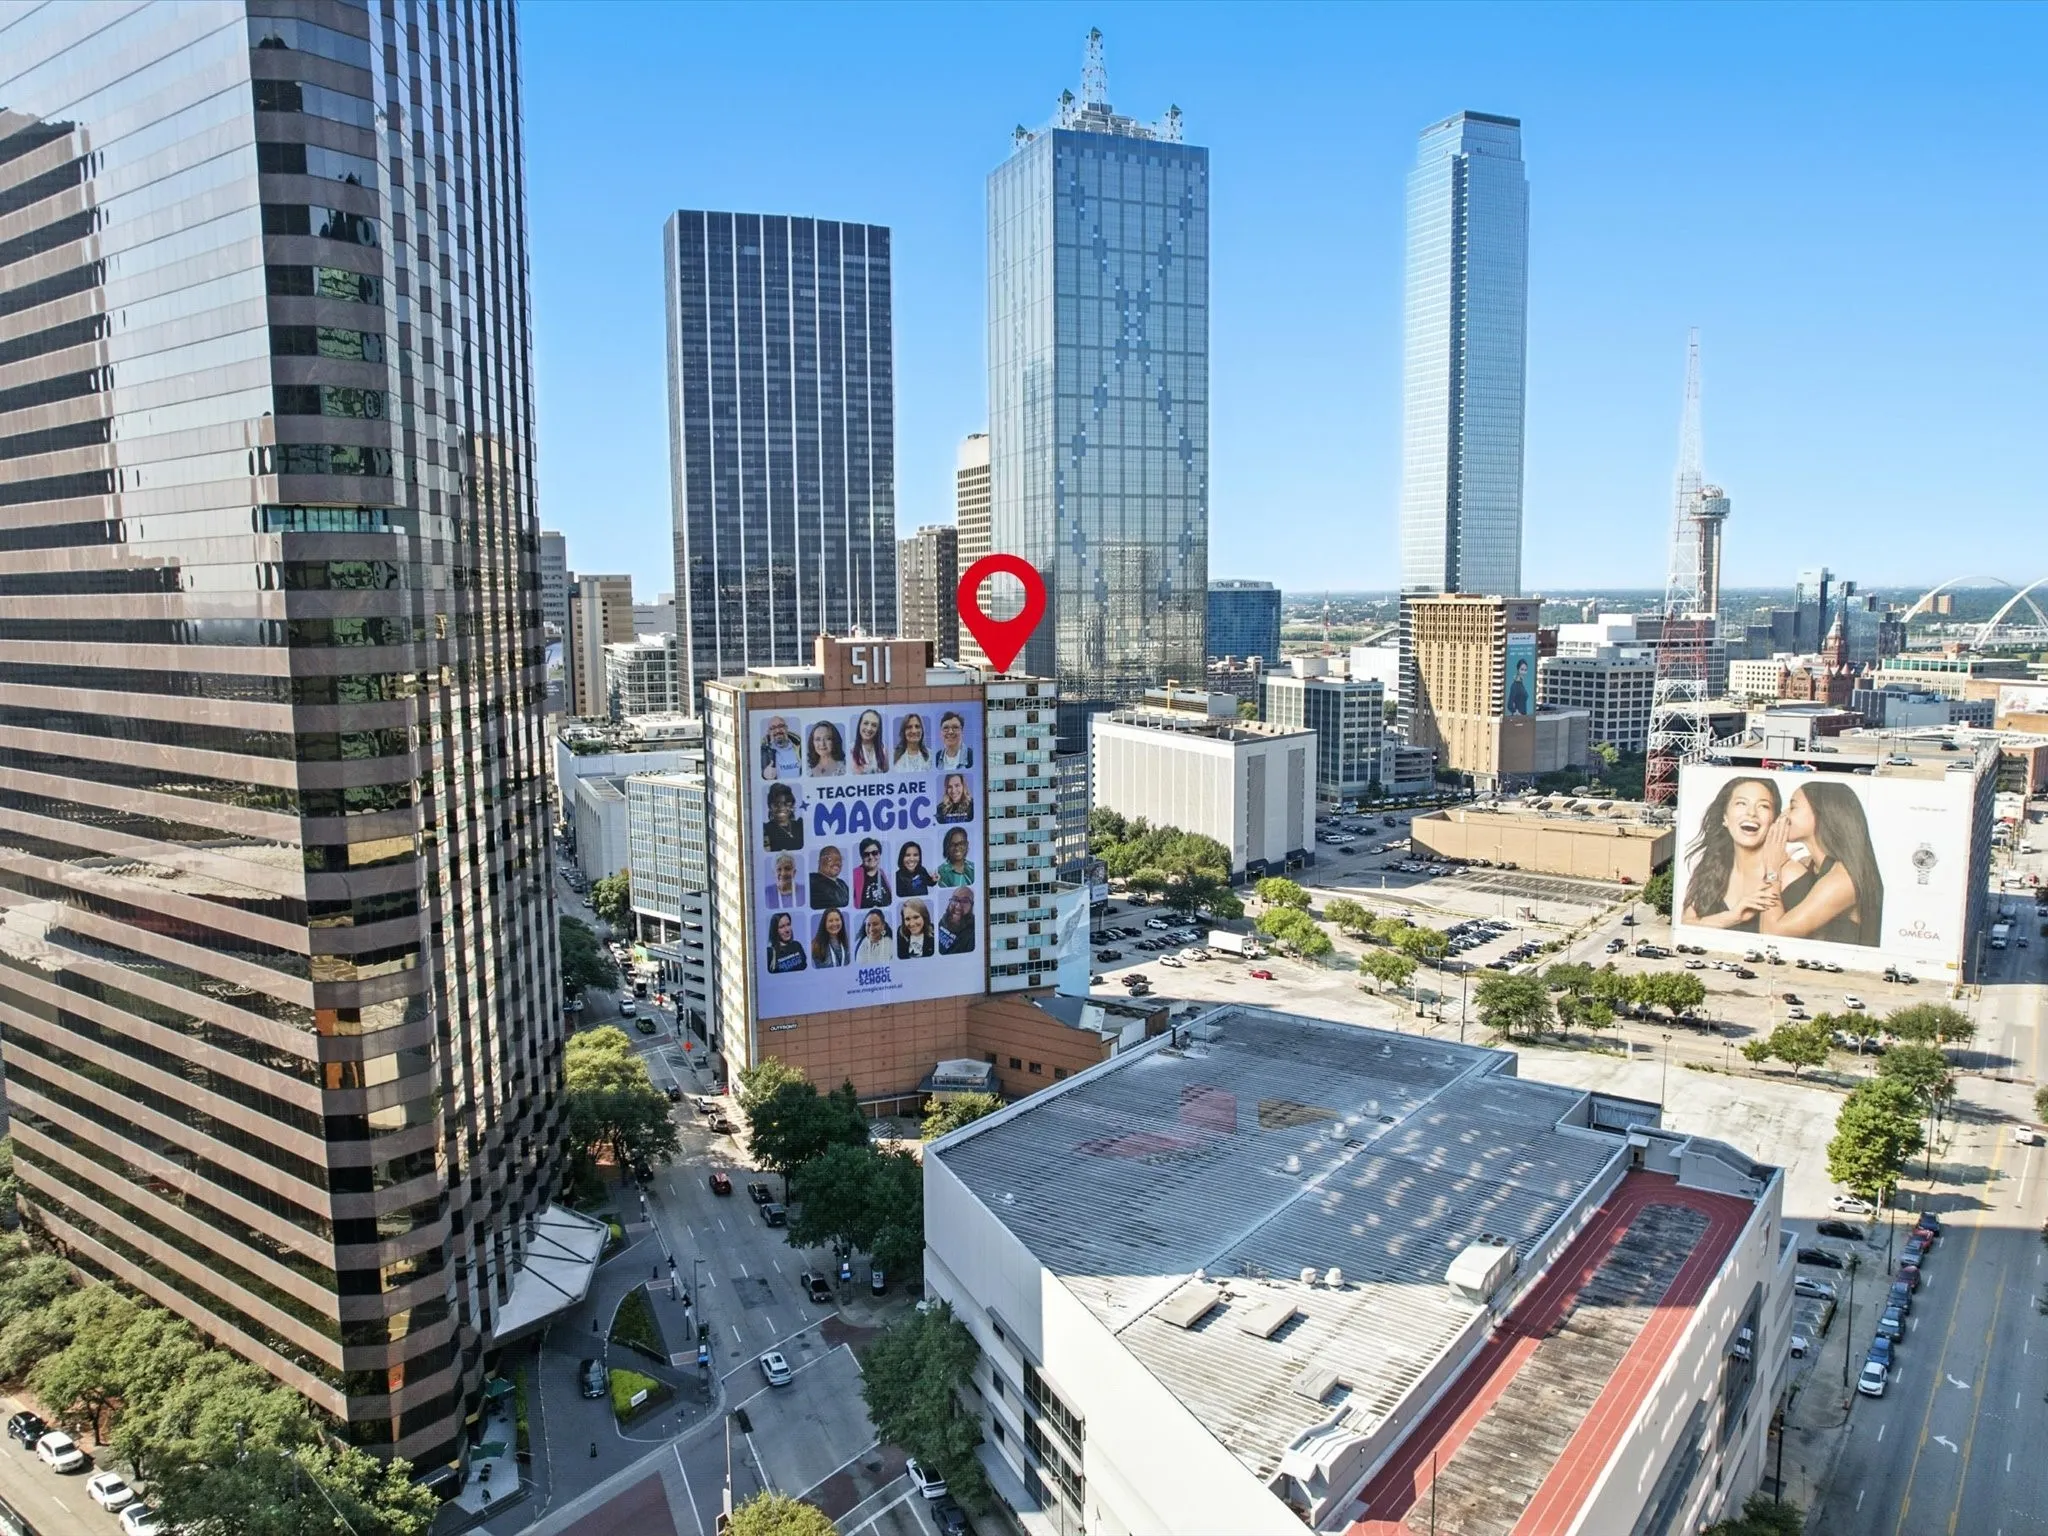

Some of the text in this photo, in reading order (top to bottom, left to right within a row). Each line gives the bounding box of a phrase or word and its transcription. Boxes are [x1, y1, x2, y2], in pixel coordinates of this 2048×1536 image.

[852, 646, 891, 684] 511
[816, 781, 927, 800] TEACHERS ARE
[1898, 928, 1941, 942] OMEGA
[859, 973, 892, 986] SCHOOL
